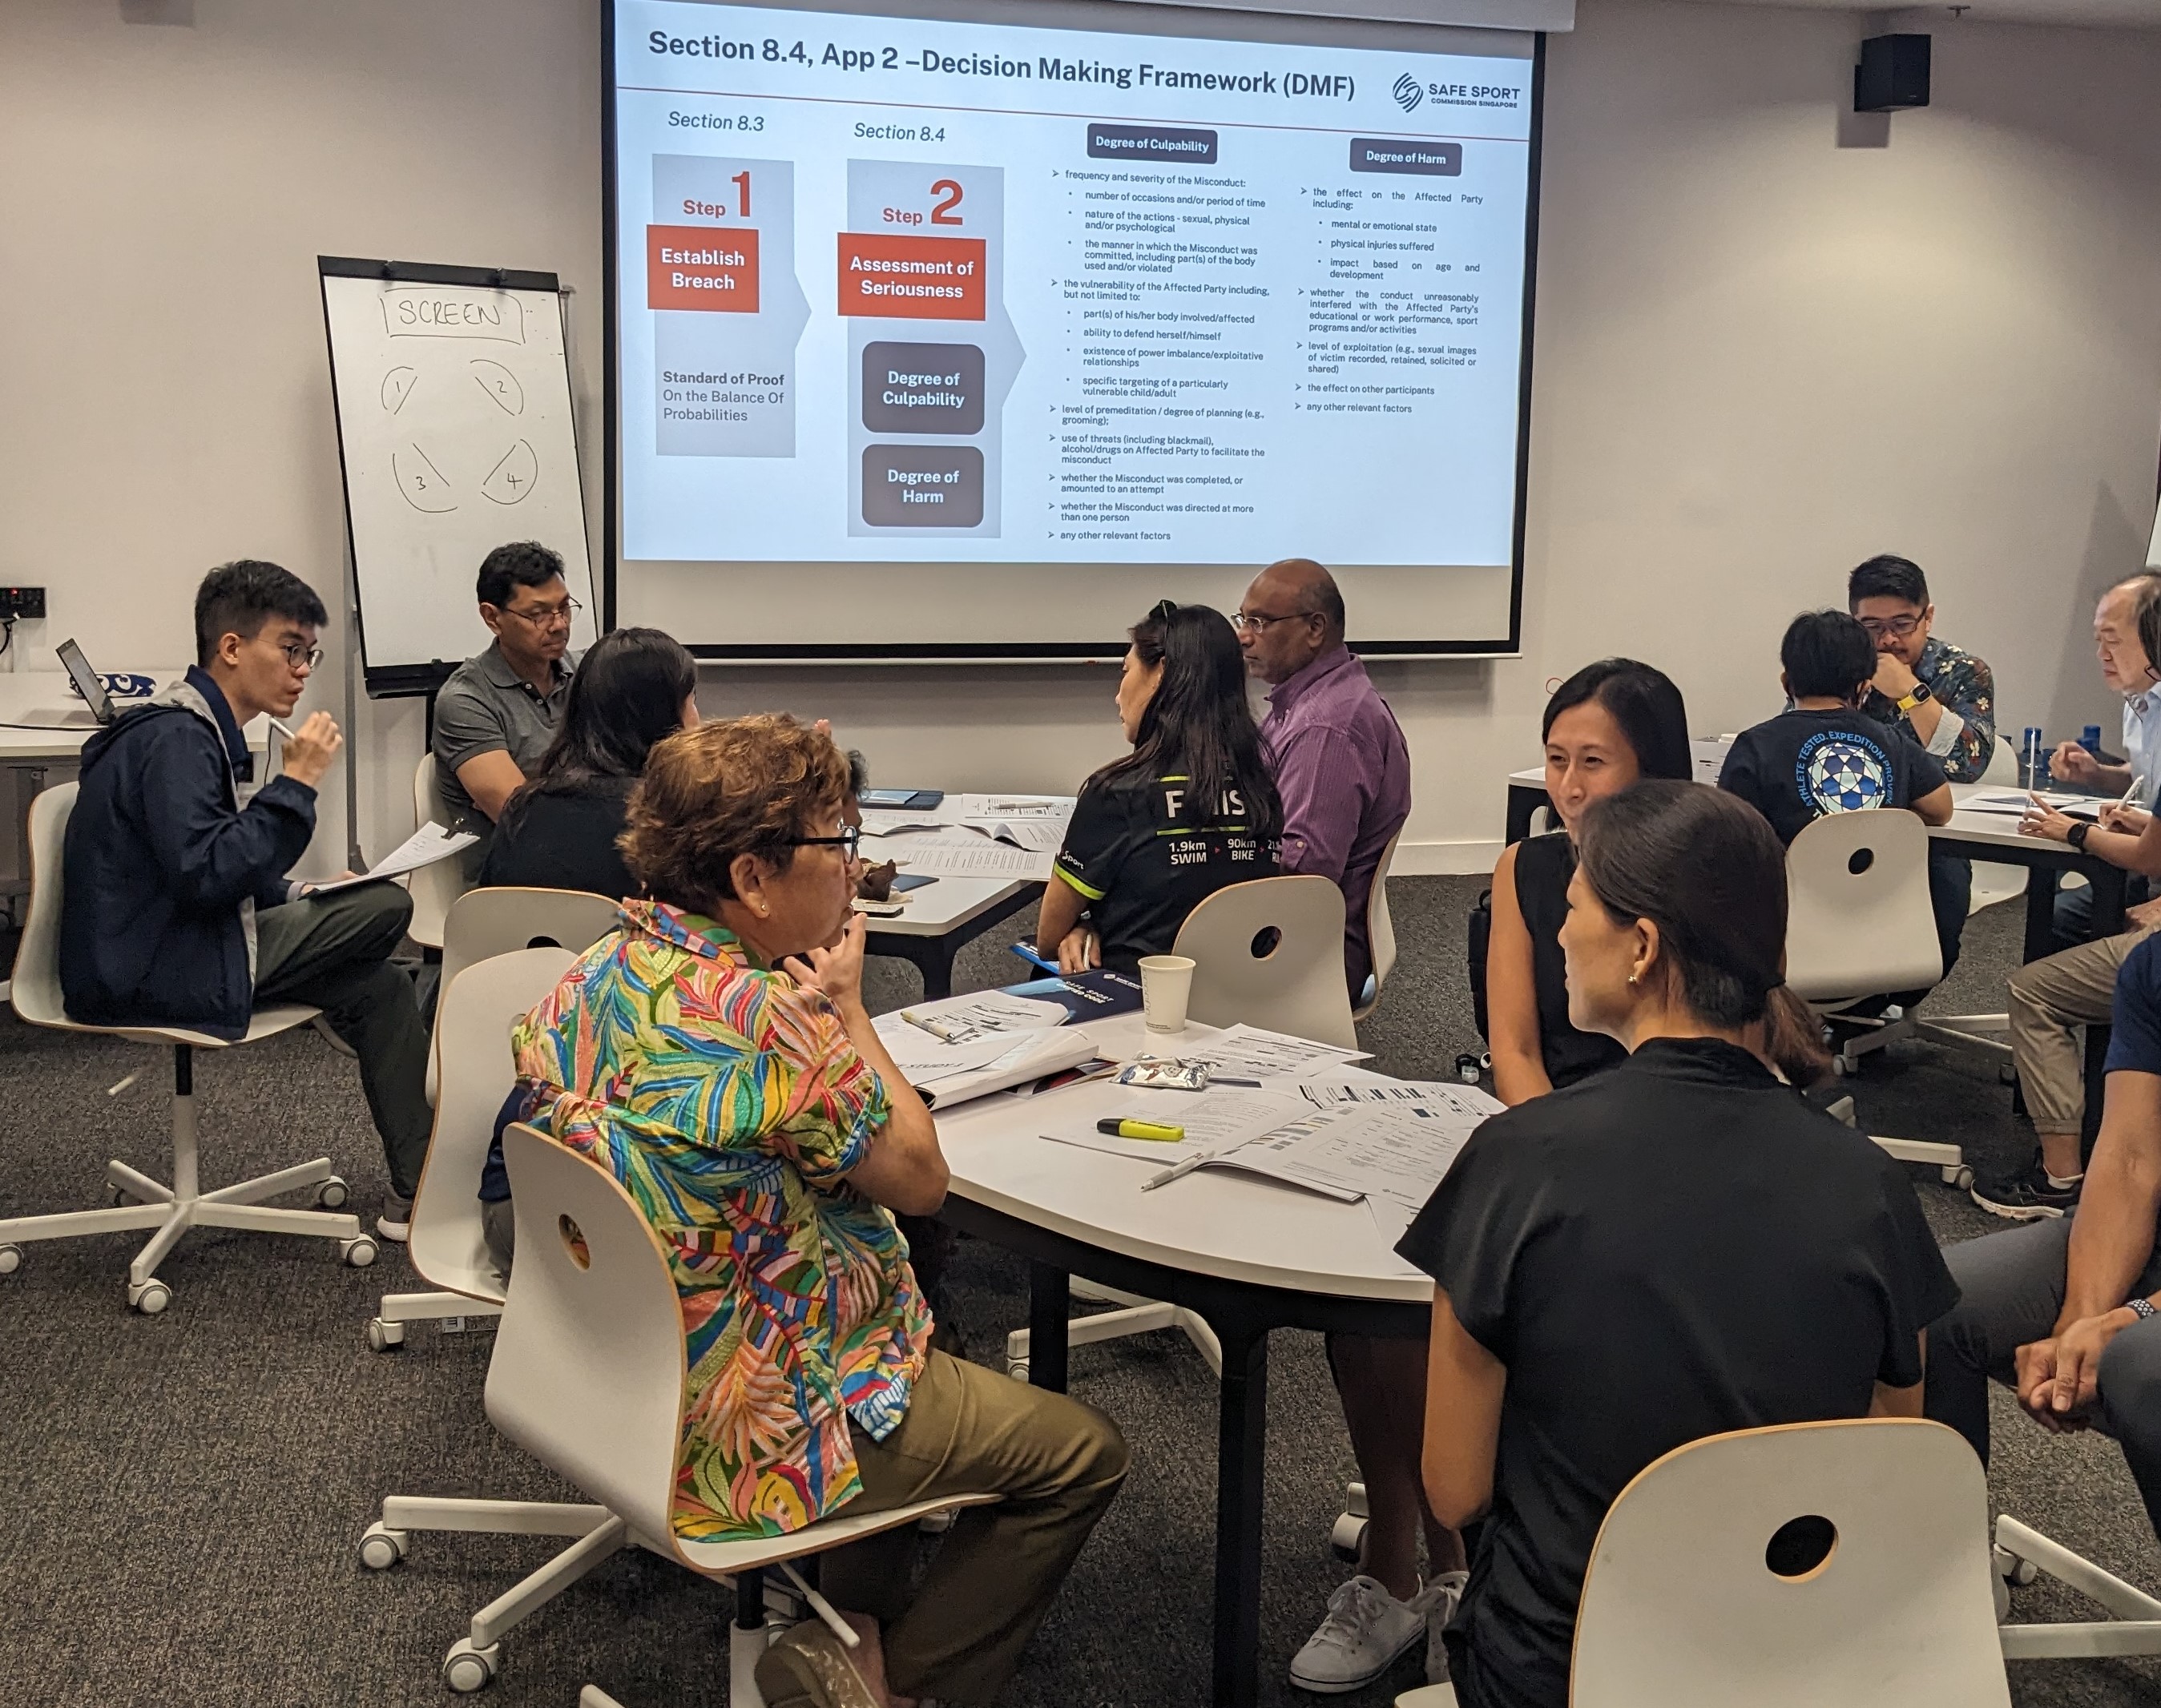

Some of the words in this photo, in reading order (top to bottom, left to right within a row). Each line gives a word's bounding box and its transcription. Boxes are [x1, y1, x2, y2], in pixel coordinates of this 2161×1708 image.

[648, 30, 754, 60] Section
[762, 38, 812, 68] 8.4,
[821, 42, 874, 71] App
[881, 46, 898, 70] 2
[1039, 57, 1132, 89] Making
[1139, 63, 1276, 93] Framework
[1283, 72, 1354, 102] (DMF)
[1429, 83, 1467, 97] SAFE
[1471, 86, 1520, 99] SPORT
[1430, 98, 1477, 106] COMMISSION
[1478, 100, 1517, 108] SINGAPORE
[667, 111, 732, 129] Section
[737, 115, 764, 131] 8.3
[853, 122, 915, 140] Section
[920, 126, 945, 142] 8.4
[1095, 135, 1135, 149] Degree
[1136, 138, 1148, 148] of
[1150, 139, 1209, 154] Culpability
[1366, 150, 1403, 163] Degree
[1405, 152, 1416, 163] of
[1417, 153, 1445, 164] Harm
[1065, 169, 1110, 182] frequency
[1111, 172, 1128, 181] and
[1130, 174, 1165, 185] severity
[1166, 175, 1176, 183] of
[1178, 175, 1192, 185] the
[1194, 175, 1246, 187] Misconduct:
[683, 199, 725, 219] Step
[732, 171, 750, 217] 1
[883, 207, 922, 226] Step
[930, 179, 963, 225] 2
[1085, 191, 1119, 200] number
[1120, 191, 1130, 201] of
[1131, 193, 1175, 203] occasions
[1176, 195, 1205, 204] and/or
[1206, 196, 1234, 207] period
[1235, 197, 1244, 207] of
[1246, 198, 1265, 207] time
[1313, 187, 1327, 196] the
[1336, 188, 1362, 198] effect
[1391, 191, 1405, 200] the
[1414, 191, 1452, 202] Affected
[1461, 194, 1483, 205] Party
[1312, 199, 1353, 211] including:
[1331, 220, 1361, 228] mental
[1373, 222, 1413, 231] emotional
[1415, 224, 1437, 232] state
[1330, 238, 1365, 249] physical
[1367, 240, 1397, 251] injuries
[1398, 241, 1434, 252] suffered
[661, 248, 744, 266] Establish
[849, 256, 953, 275] Assessment
[957, 260, 974, 275] of
[672, 272, 734, 289] Breach
[1063, 279, 1078, 288] the
[1080, 280, 1135, 292] vulnerability
[1136, 281, 1146, 290] of
[1147, 282, 1162, 291] the
[1163, 282, 1202, 292] Affected
[1203, 284, 1227, 295] Party
[1228, 285, 1269, 296] including,
[861, 280, 962, 298] Seriousness
[1063, 290, 1078, 299] but
[1080, 291, 1095, 299] not
[1096, 291, 1127, 300] limited
[1129, 292, 1140, 301] to:
[399, 300, 501, 325] SCREEN
[1083, 309, 1112, 320] part(s)
[1114, 310, 1123, 319] of
[1125, 310, 1155, 320] his/her
[1157, 311, 1179, 322] body
[1180, 312, 1255, 324] involved/affected
[1083, 328, 1111, 338] ability
[1113, 329, 1122, 337] to
[1123, 328, 1155, 338] defend
[1156, 330, 1221, 340] herself/himself
[1308, 341, 1328, 350] level
[1331, 342, 1341, 351] of
[1343, 343, 1393, 352] exploitation
[1395, 344, 1414, 354] (e.g.,
[1417, 345, 1445, 354] sexual
[1447, 345, 1477, 356] images
[1308, 352, 1317, 361] of
[1320, 353, 1345, 362] victim
[1348, 354, 1388, 365] recorded,
[1390, 356, 1427, 365] retained,
[1429, 357, 1465, 365] solicited
[663, 370, 727, 384] Standard
[730, 373, 744, 385] of
[748, 373, 784, 385] Proof
[1308, 365, 1339, 374] shared)
[888, 370, 941, 387] Degree
[944, 373, 960, 385] of
[396, 381, 401, 393] 1
[497, 381, 508, 393] 2
[1308, 383, 1321, 392] the
[1322, 383, 1348, 393] effect
[1361, 385, 1384, 393] other
[1385, 385, 1434, 396] participants
[663, 389, 682, 401] On
[685, 389, 708, 402] the
[712, 390, 764, 403] Balance
[768, 392, 784, 404] Of
[882, 390, 965, 409] Culpability
[663, 407, 748, 421] Probabilities
[1306, 404, 1322, 412] any
[1323, 402, 1346, 411] other
[1347, 403, 1381, 412] relevant
[1382, 403, 1412, 413] factors
[416, 476, 426, 490] 3
[507, 473, 524, 490] 4
[888, 469, 941, 485] Degree
[944, 470, 959, 483] of
[1061, 473, 1097, 482] whether
[1099, 473, 1113, 482] the
[1115, 473, 1164, 483] Misconduct
[1185, 475, 1232, 485] completed,
[903, 489, 943, 503] Harm
[1061, 485, 1104, 493] amounted
[1107, 485, 1115, 493] to
[1129, 485, 1164, 495] attempt
[1060, 532, 1076, 541] any
[1078, 530, 1101, 539] other
[1103, 530, 1139, 539] relevant
[1140, 531, 1171, 540] factors
[1798, 732, 1829, 760] TESTED.
[1828, 731, 1886, 761] EXPEDITION
[1796, 761, 1815, 808] ATHLETE
[1882, 759, 1893, 805] PROVEN
[1168, 840, 1207, 853] 1.9km
[1228, 838, 1256, 849] 90km
[1062, 850, 1084, 870] Sport
[1171, 852, 1207, 865] SWIM
[1231, 850, 1255, 861] BIKE
